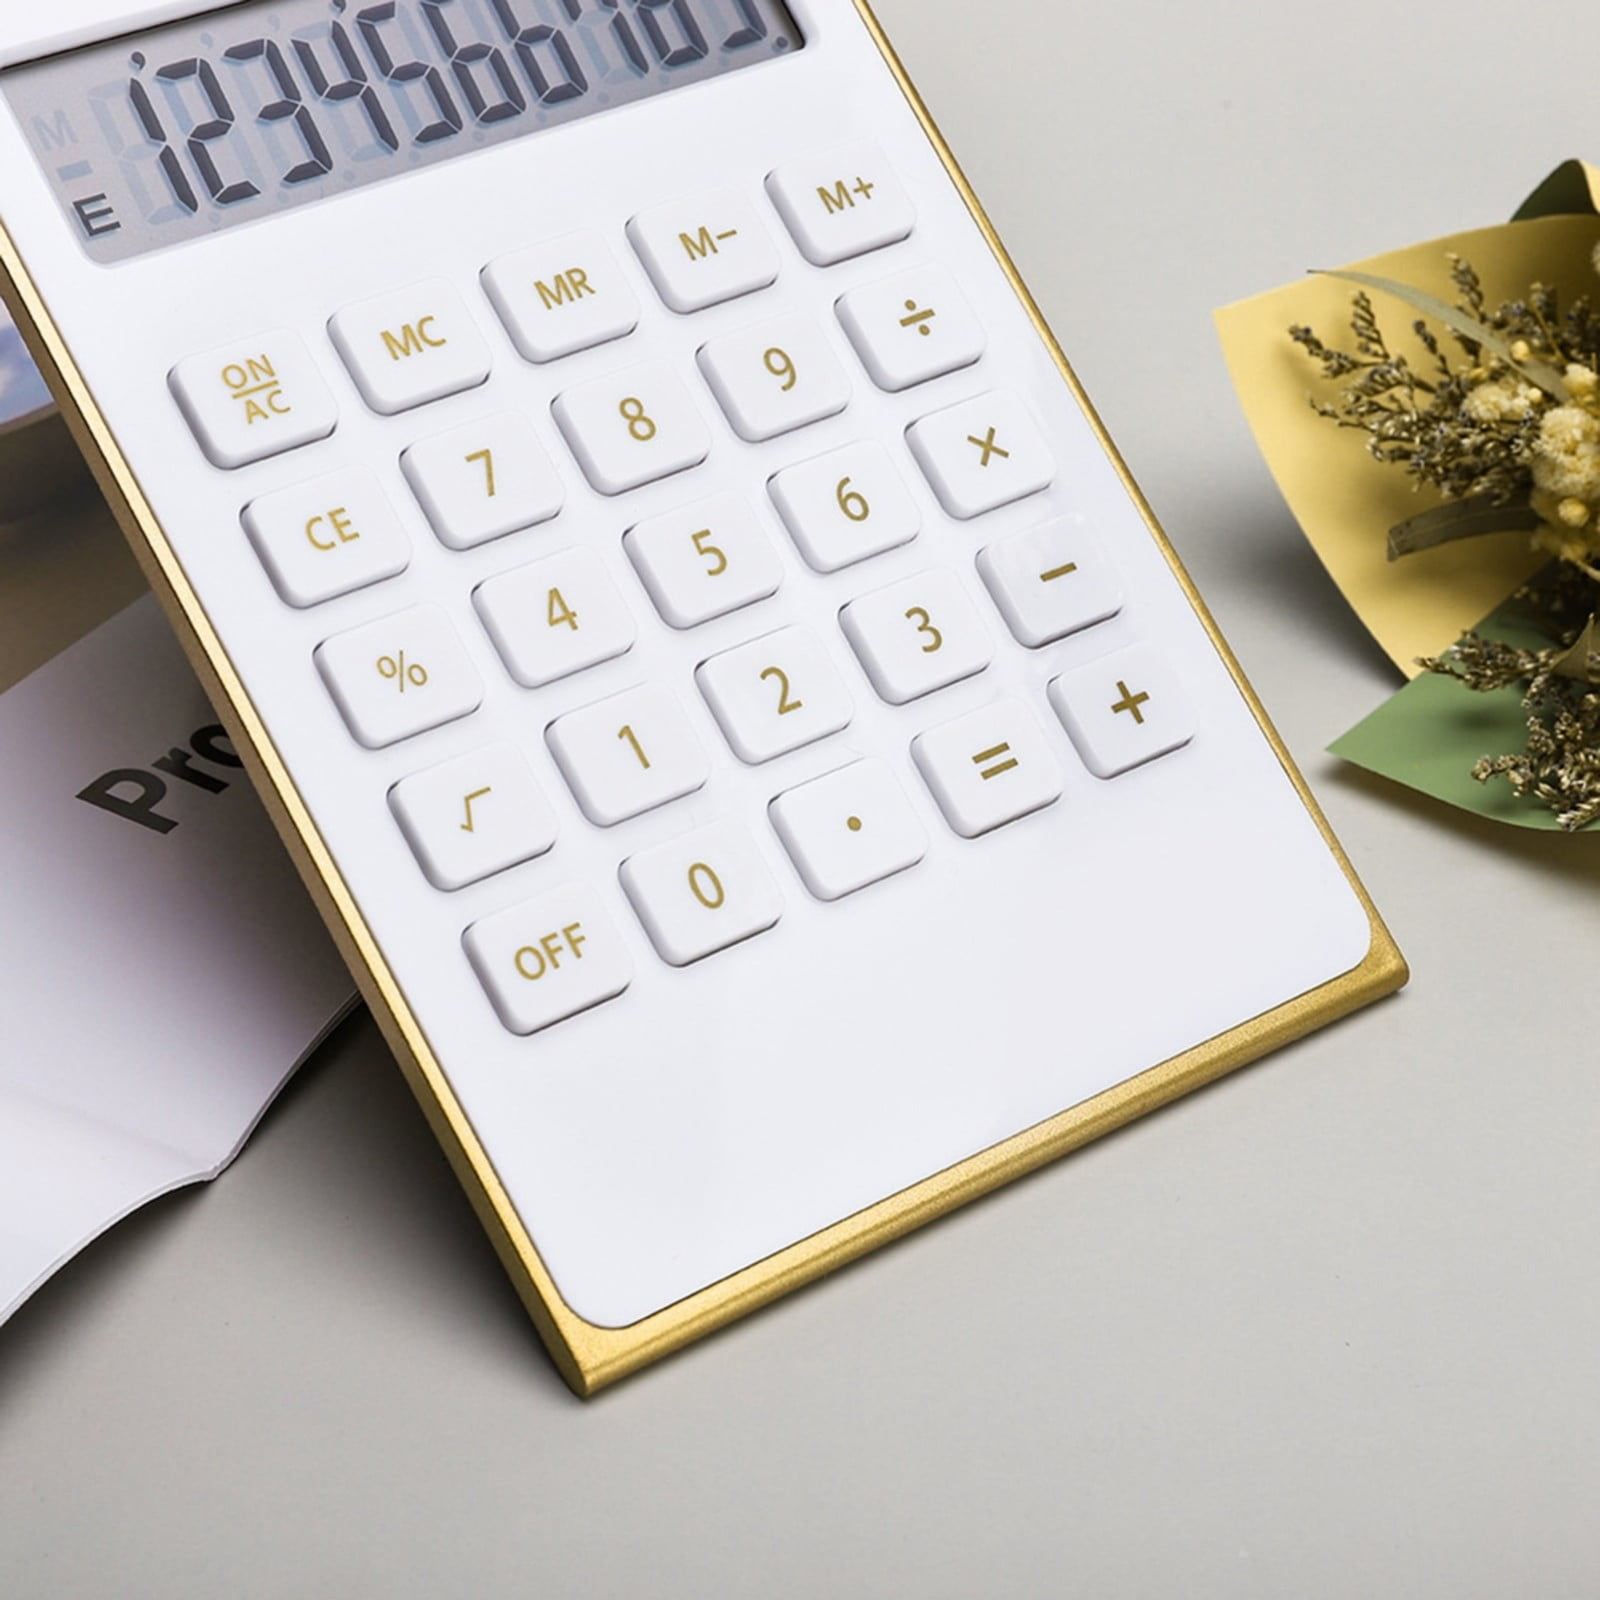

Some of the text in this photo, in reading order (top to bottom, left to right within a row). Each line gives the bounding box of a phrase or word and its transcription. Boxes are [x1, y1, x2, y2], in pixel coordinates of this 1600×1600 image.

[72, 192, 121, 237] E
[817, 177, 875, 214] M+
[679, 226, 738, 261] M-
[534, 267, 596, 310] MR
[381, 315, 447, 361] MC
[221, 353, 276, 390] ON
[763, 347, 797, 391] 9
[244, 388, 292, 425] AC
[619, 397, 657, 442] 8
[464, 449, 496, 498] 7
[836, 477, 870, 522] 6
[305, 506, 361, 553] CE
[691, 529, 728, 576] 5
[546, 587, 579, 631] 4
[905, 606, 943, 653] 3
[376, 649, 429, 693] %
[760, 667, 803, 715] 2
[616, 724, 651, 771] 1
[687, 862, 726, 910] 0
[513, 921, 588, 981] OFF
